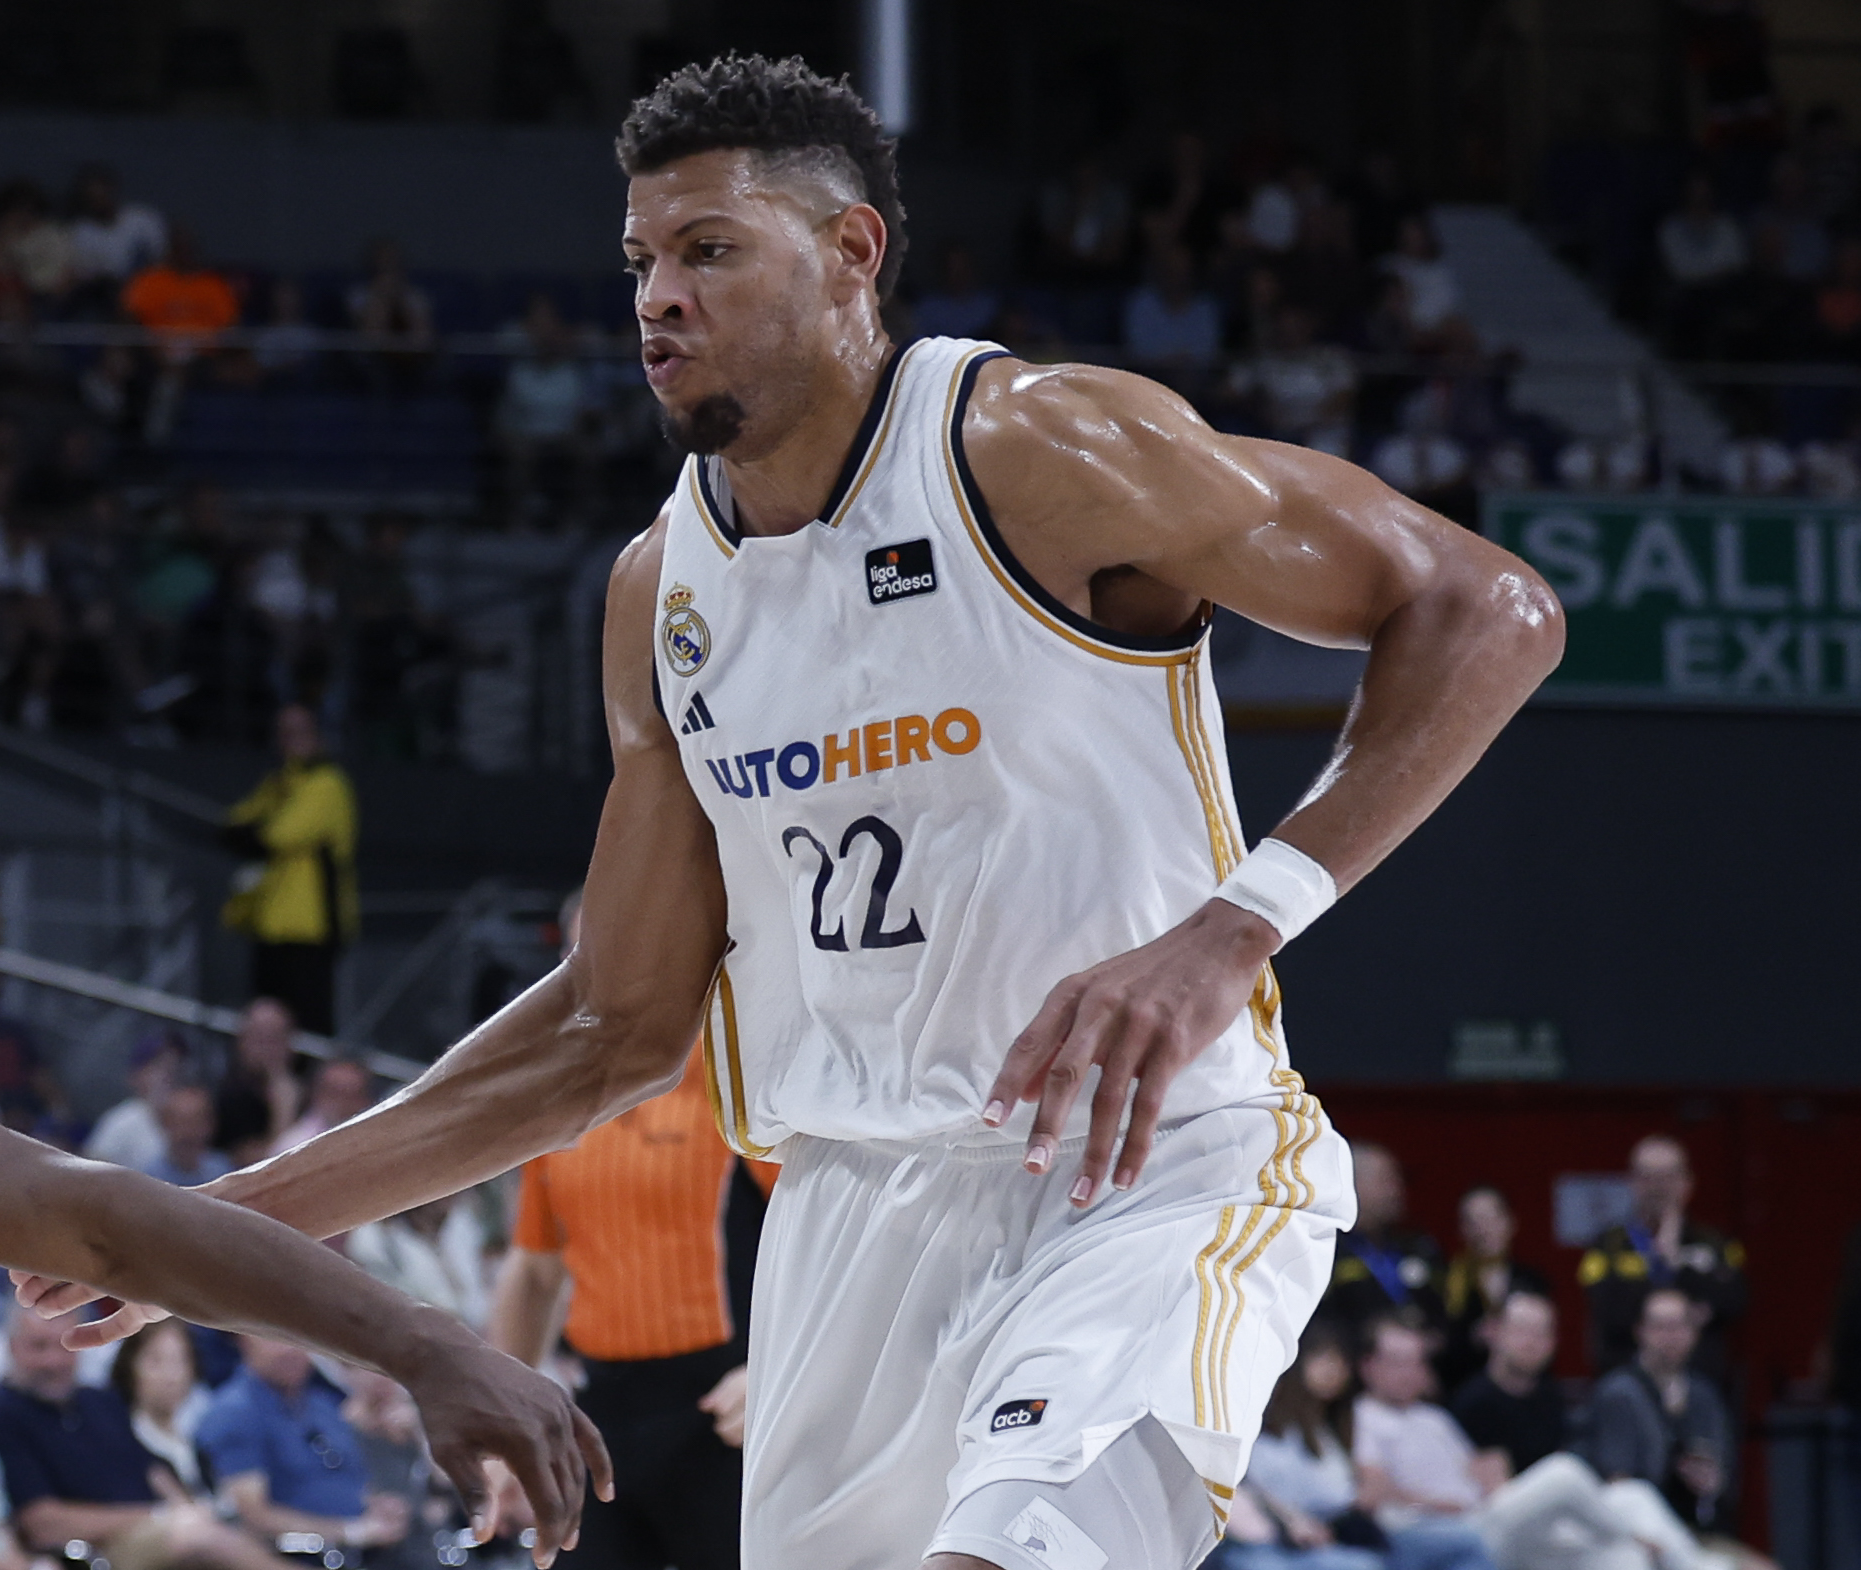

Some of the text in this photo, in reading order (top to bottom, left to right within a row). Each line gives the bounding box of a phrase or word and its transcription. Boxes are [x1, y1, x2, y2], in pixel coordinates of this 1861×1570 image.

[870, 565, 898, 583] liga
[873, 574, 933, 599] endesa
[781, 815, 926, 952] 22
[993, 1408, 1032, 1429] acb
